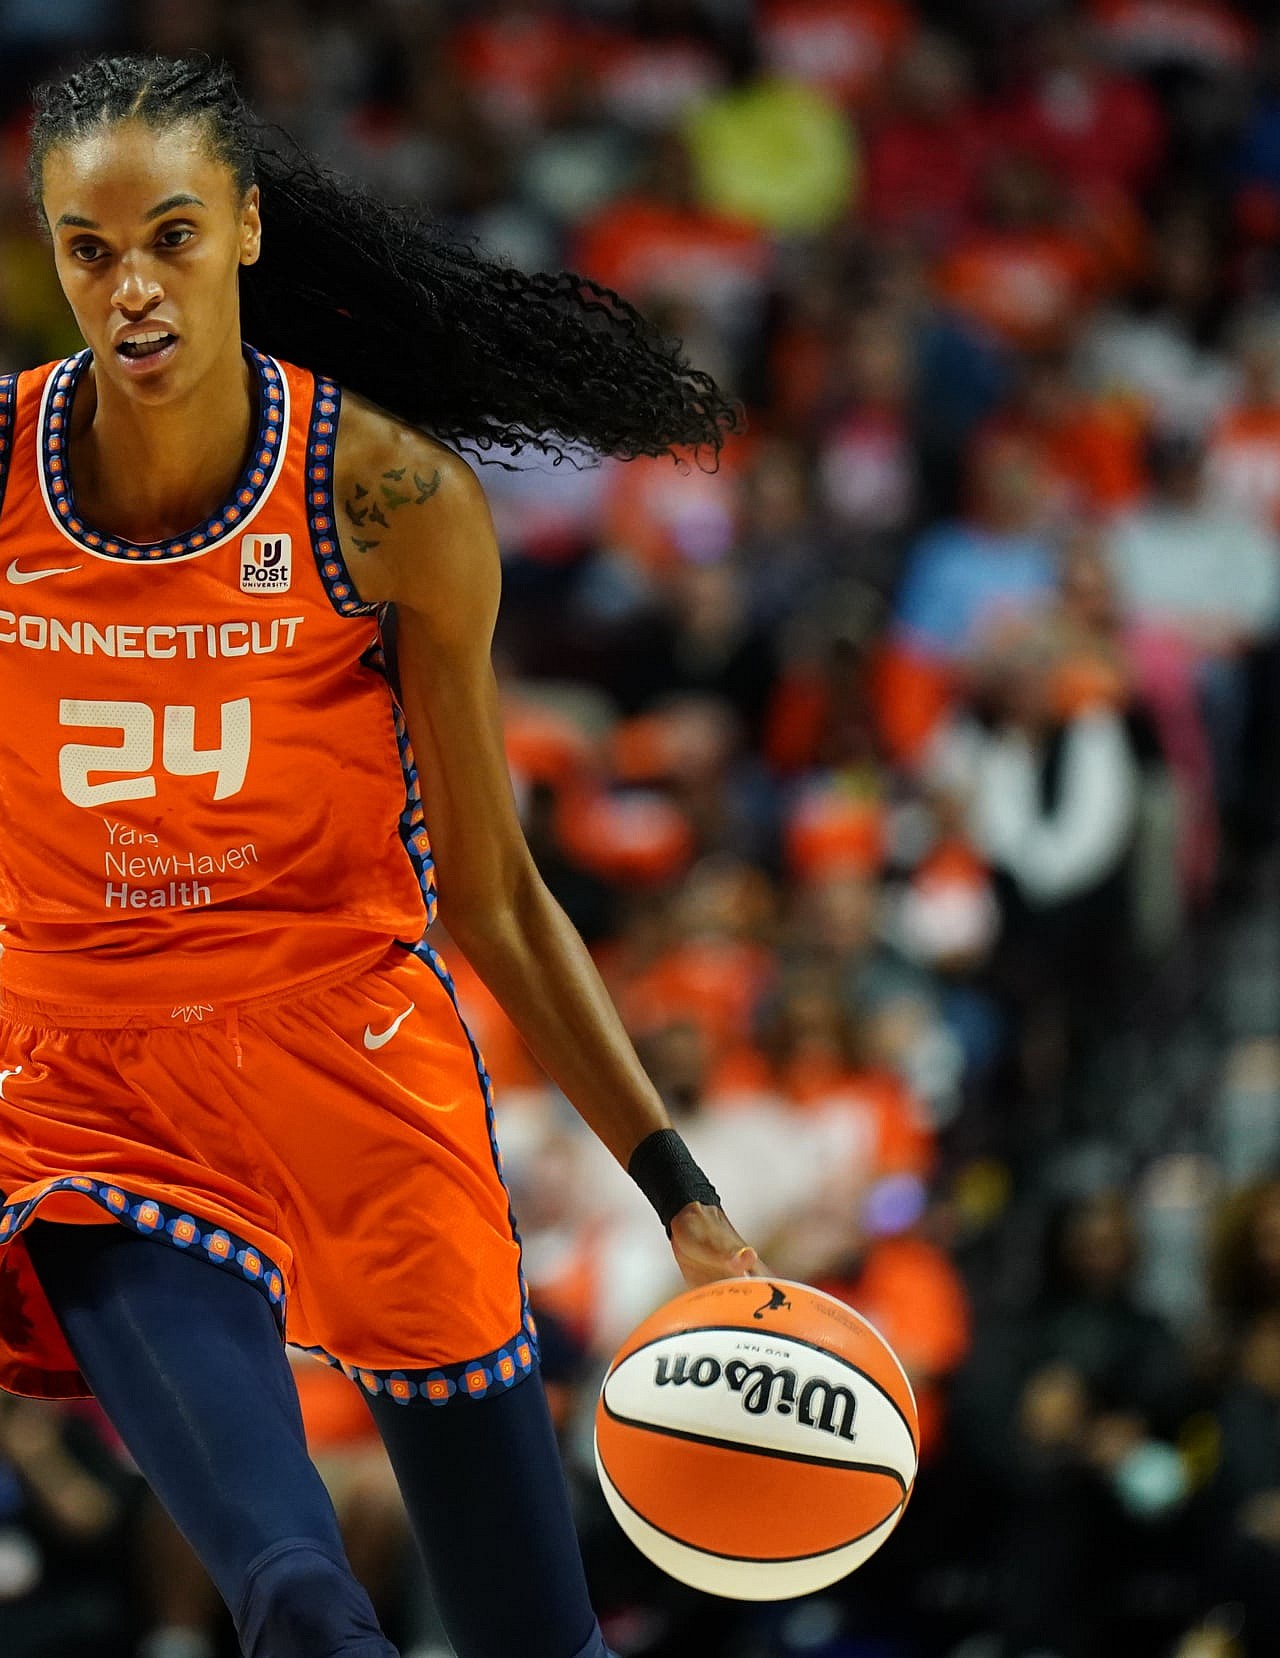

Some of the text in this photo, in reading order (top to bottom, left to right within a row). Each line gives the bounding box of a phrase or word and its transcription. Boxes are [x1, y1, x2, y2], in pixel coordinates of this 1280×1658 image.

[243, 564, 288, 581] Post
[58, 697, 252, 808] 24
[105, 880, 211, 909] Health
[655, 1353, 858, 1442] Wilson
